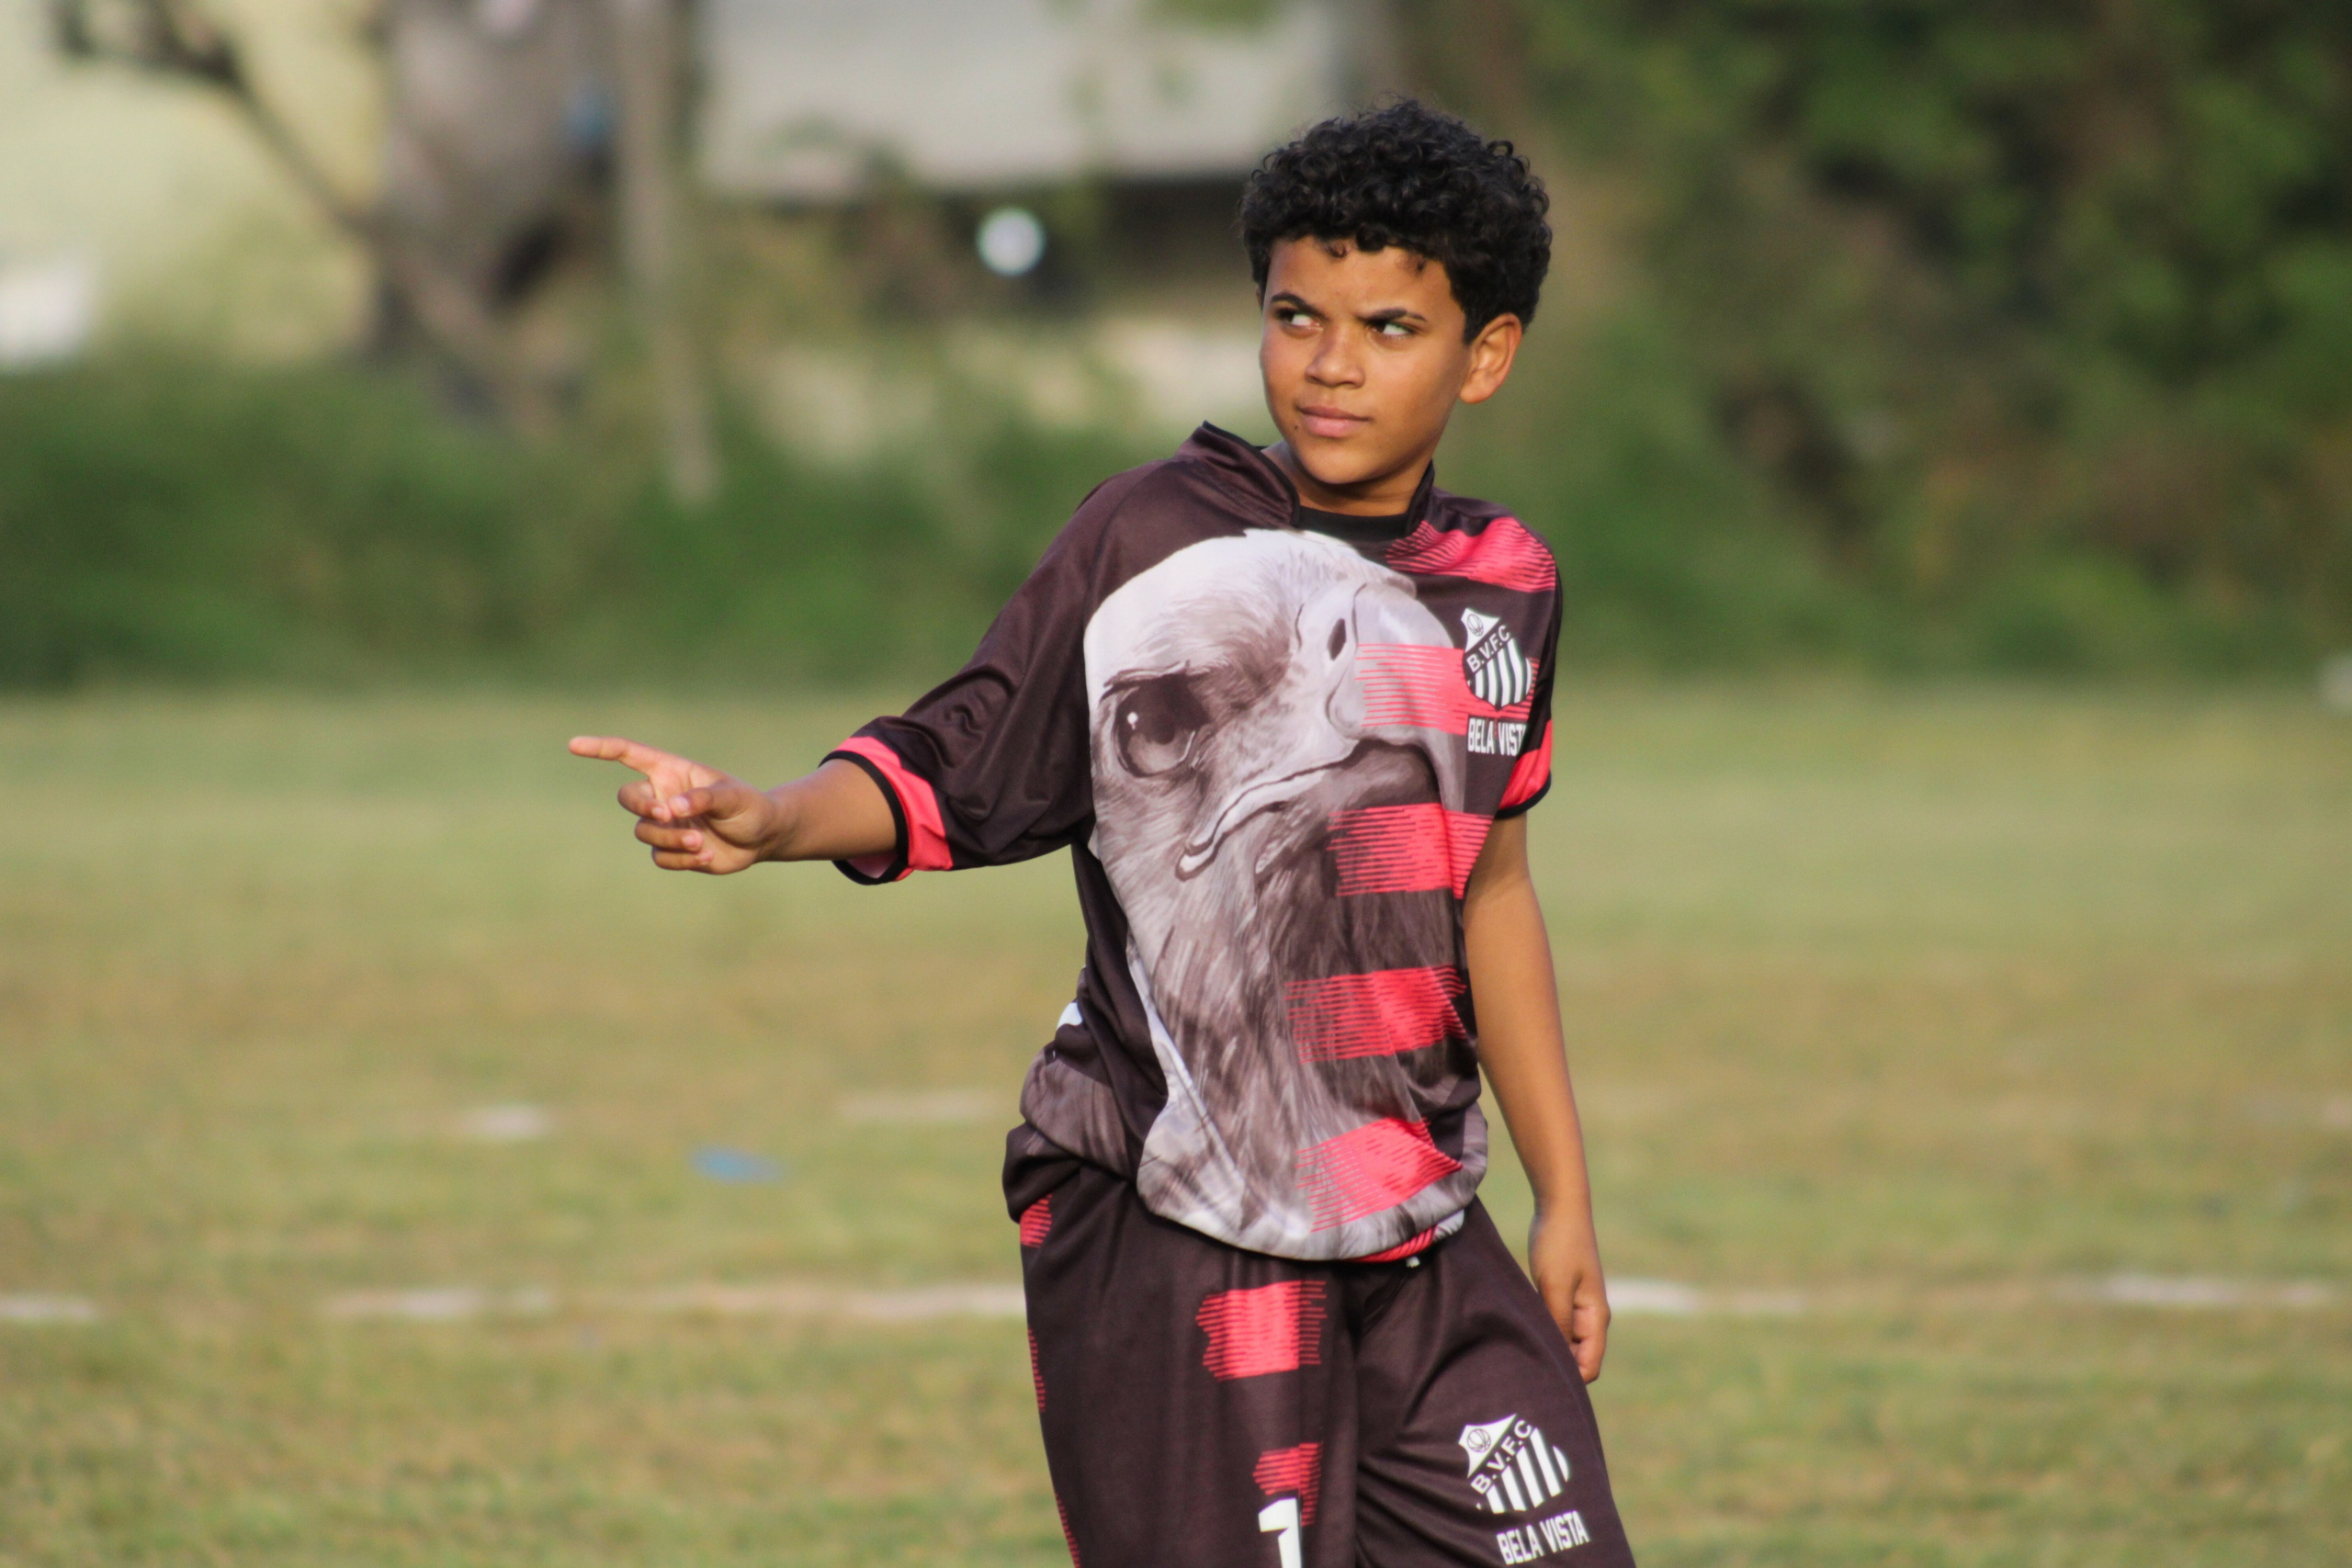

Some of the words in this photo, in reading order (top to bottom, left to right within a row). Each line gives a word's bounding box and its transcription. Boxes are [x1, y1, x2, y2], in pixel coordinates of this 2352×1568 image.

[1468, 717, 1495, 754] BELA
[1498, 721, 1528, 757] VIST
[1258, 1497, 1302, 1568] 1
[1497, 1524, 1544, 1565] BELA
[1539, 1510, 1590, 1553] VISTA
